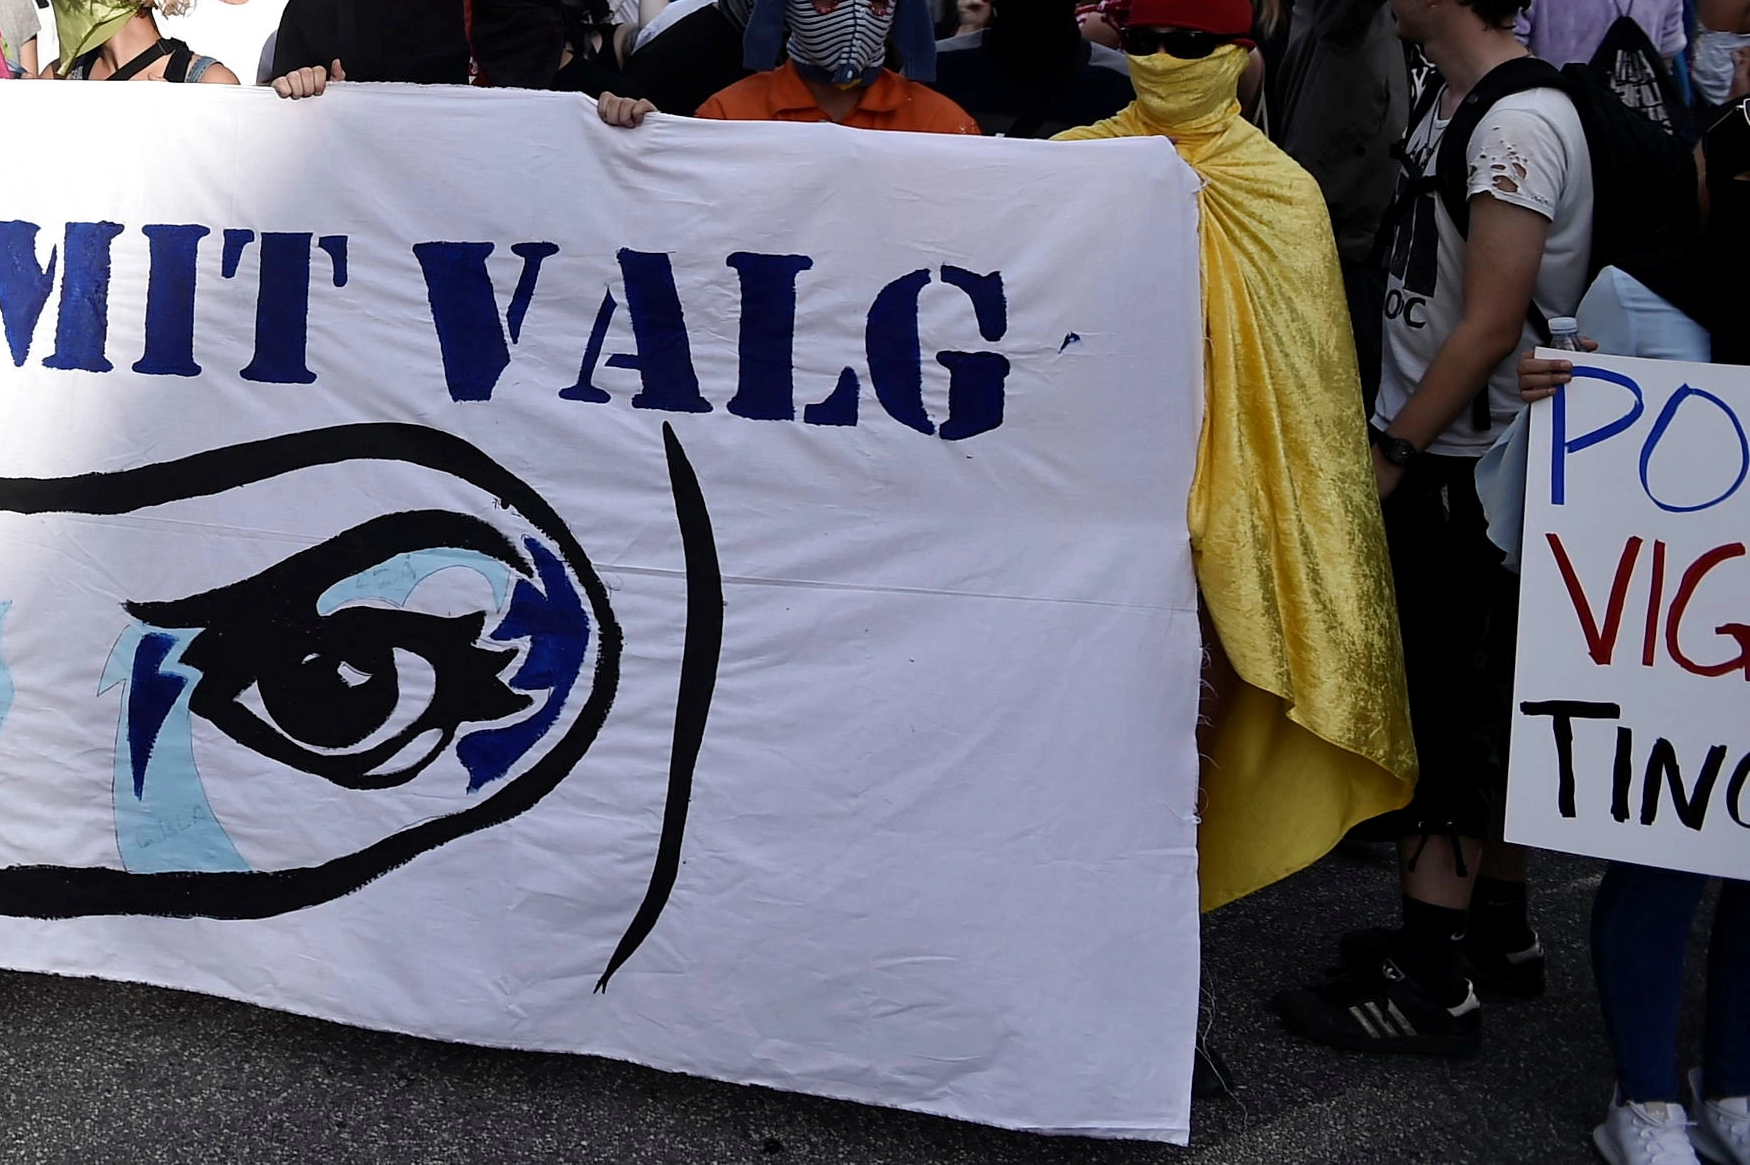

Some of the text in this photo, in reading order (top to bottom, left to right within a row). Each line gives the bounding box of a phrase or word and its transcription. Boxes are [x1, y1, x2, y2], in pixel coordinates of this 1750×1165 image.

[412, 241, 1010, 441] VALG
[1551, 365, 1749, 513] PO
[1545, 533, 1750, 681] VIG
